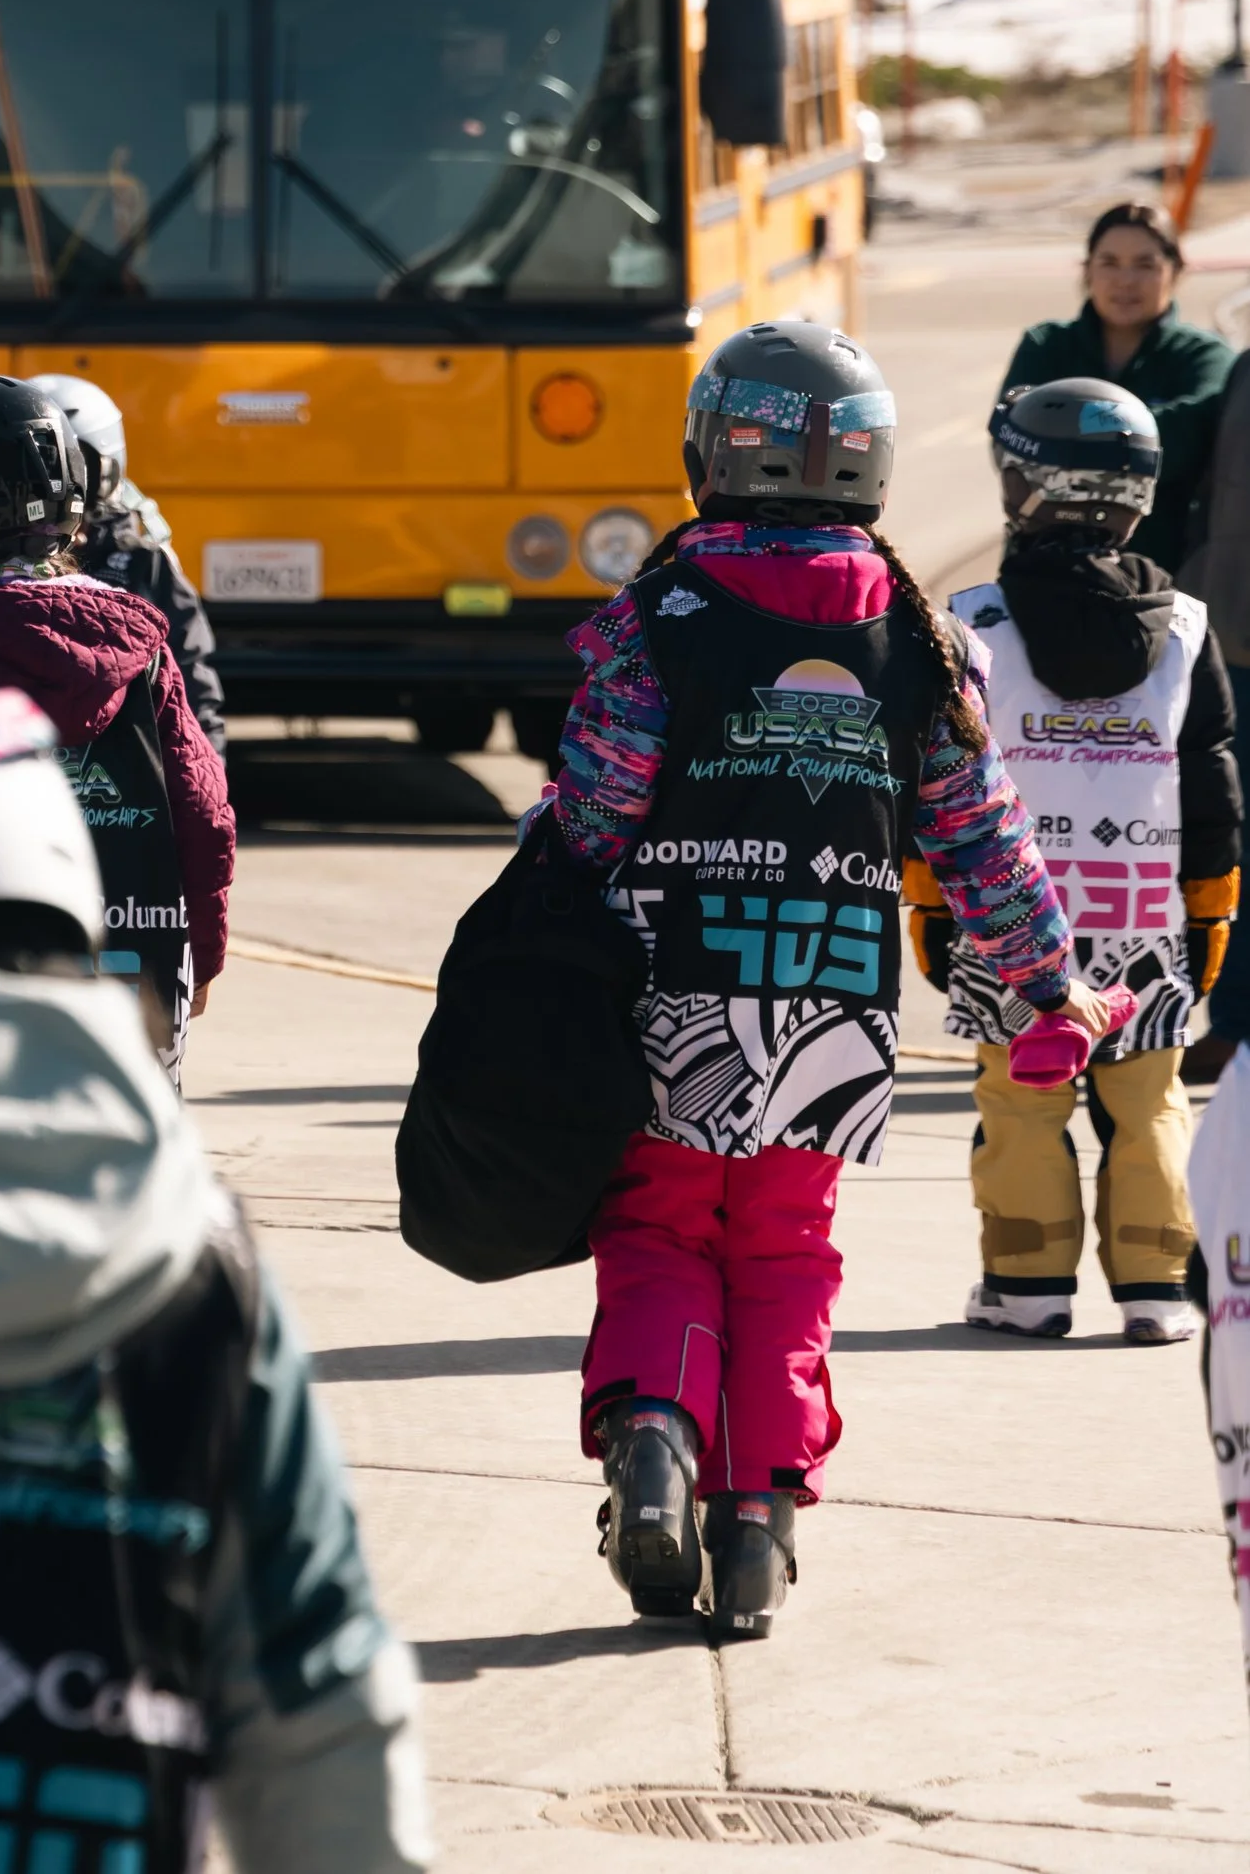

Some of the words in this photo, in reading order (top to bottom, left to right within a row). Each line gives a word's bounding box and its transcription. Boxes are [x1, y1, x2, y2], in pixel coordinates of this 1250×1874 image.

[1000, 425, 1041, 456] SMITH
[749, 483, 779, 494] SMITH
[28, 501, 44, 518] ML
[781, 692, 860, 717] 2020
[1061, 699, 1121, 715] 2020
[726, 711, 890, 769] USASA
[1022, 712, 1162, 747] USASA
[687, 754, 782, 782] NATIONAL
[634, 839, 788, 865] OODWARD
[695, 867, 746, 881] COPPER
[764, 868, 785, 883] CO
